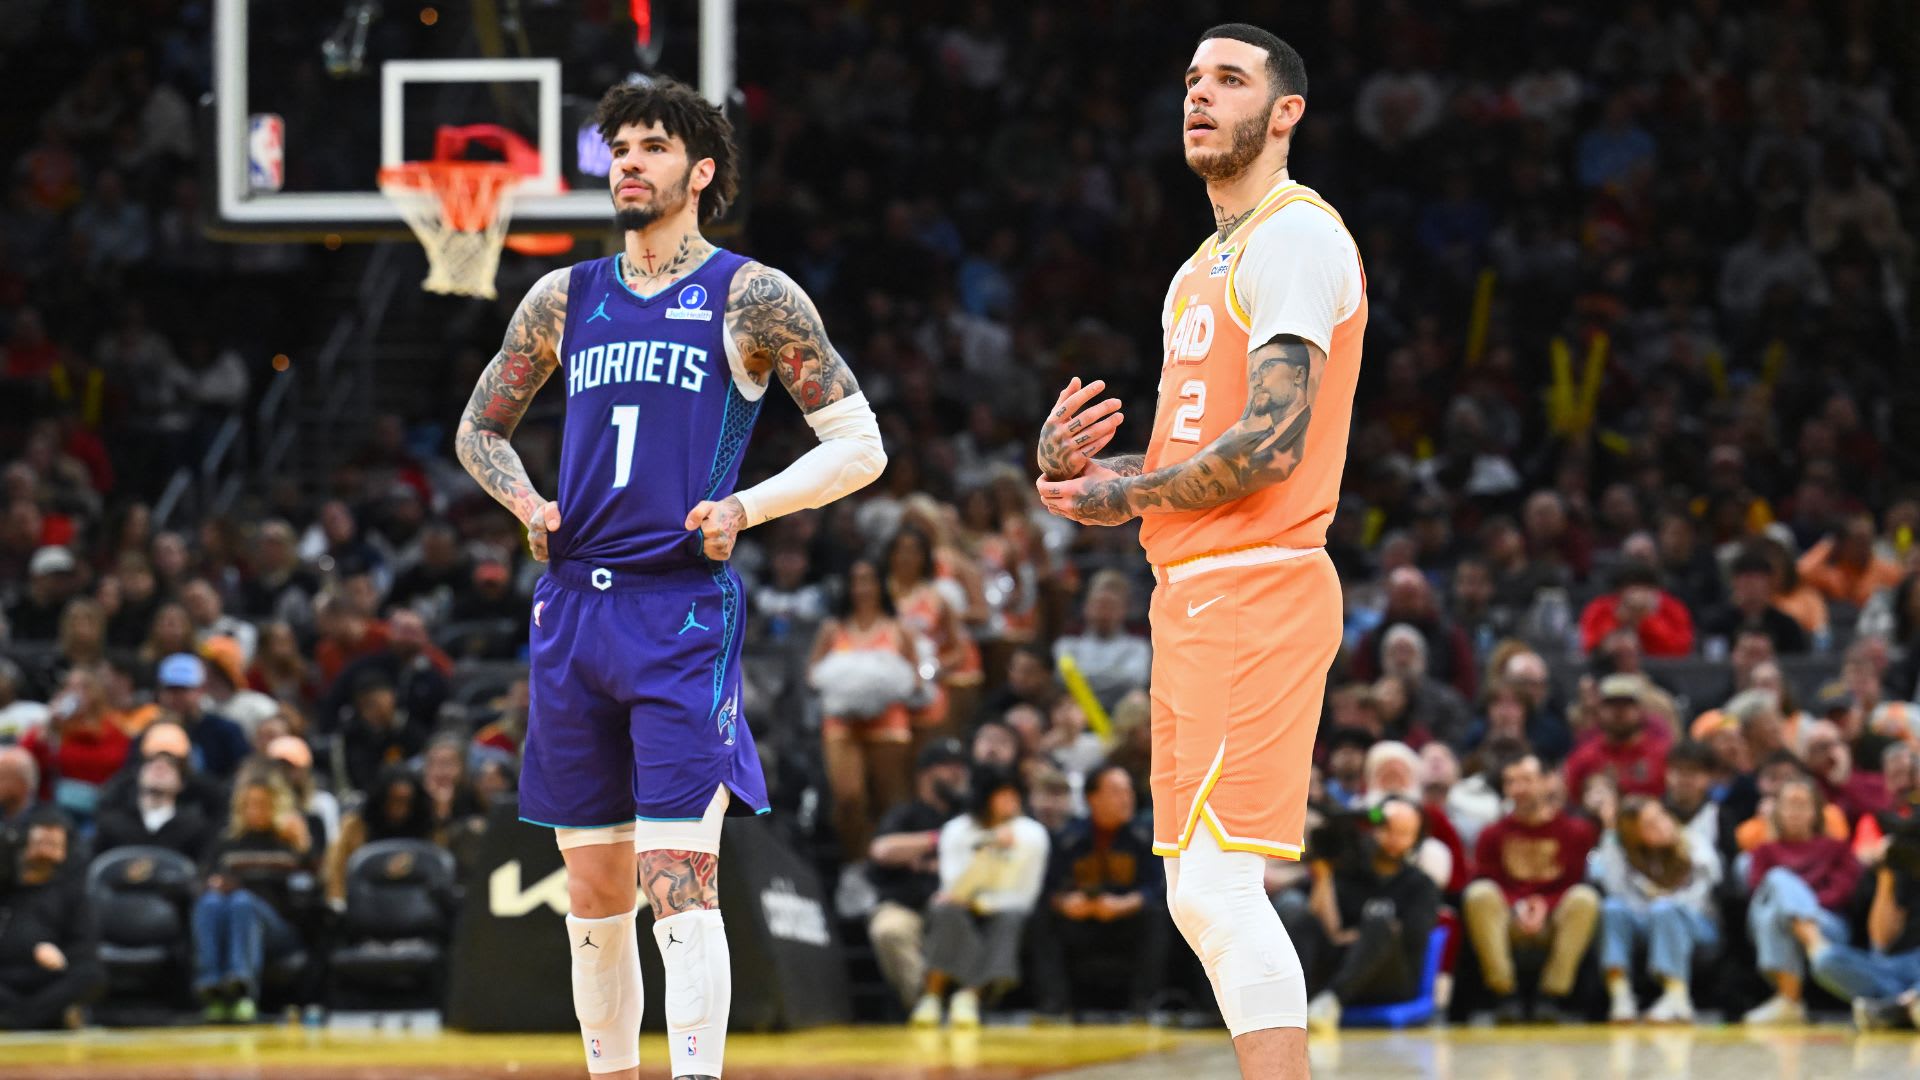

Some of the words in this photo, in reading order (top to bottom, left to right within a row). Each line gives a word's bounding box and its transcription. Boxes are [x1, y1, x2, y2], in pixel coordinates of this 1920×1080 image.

[569, 341, 710, 397] HORNETS
[1171, 379, 1206, 444] 2
[611, 404, 640, 488] 1
